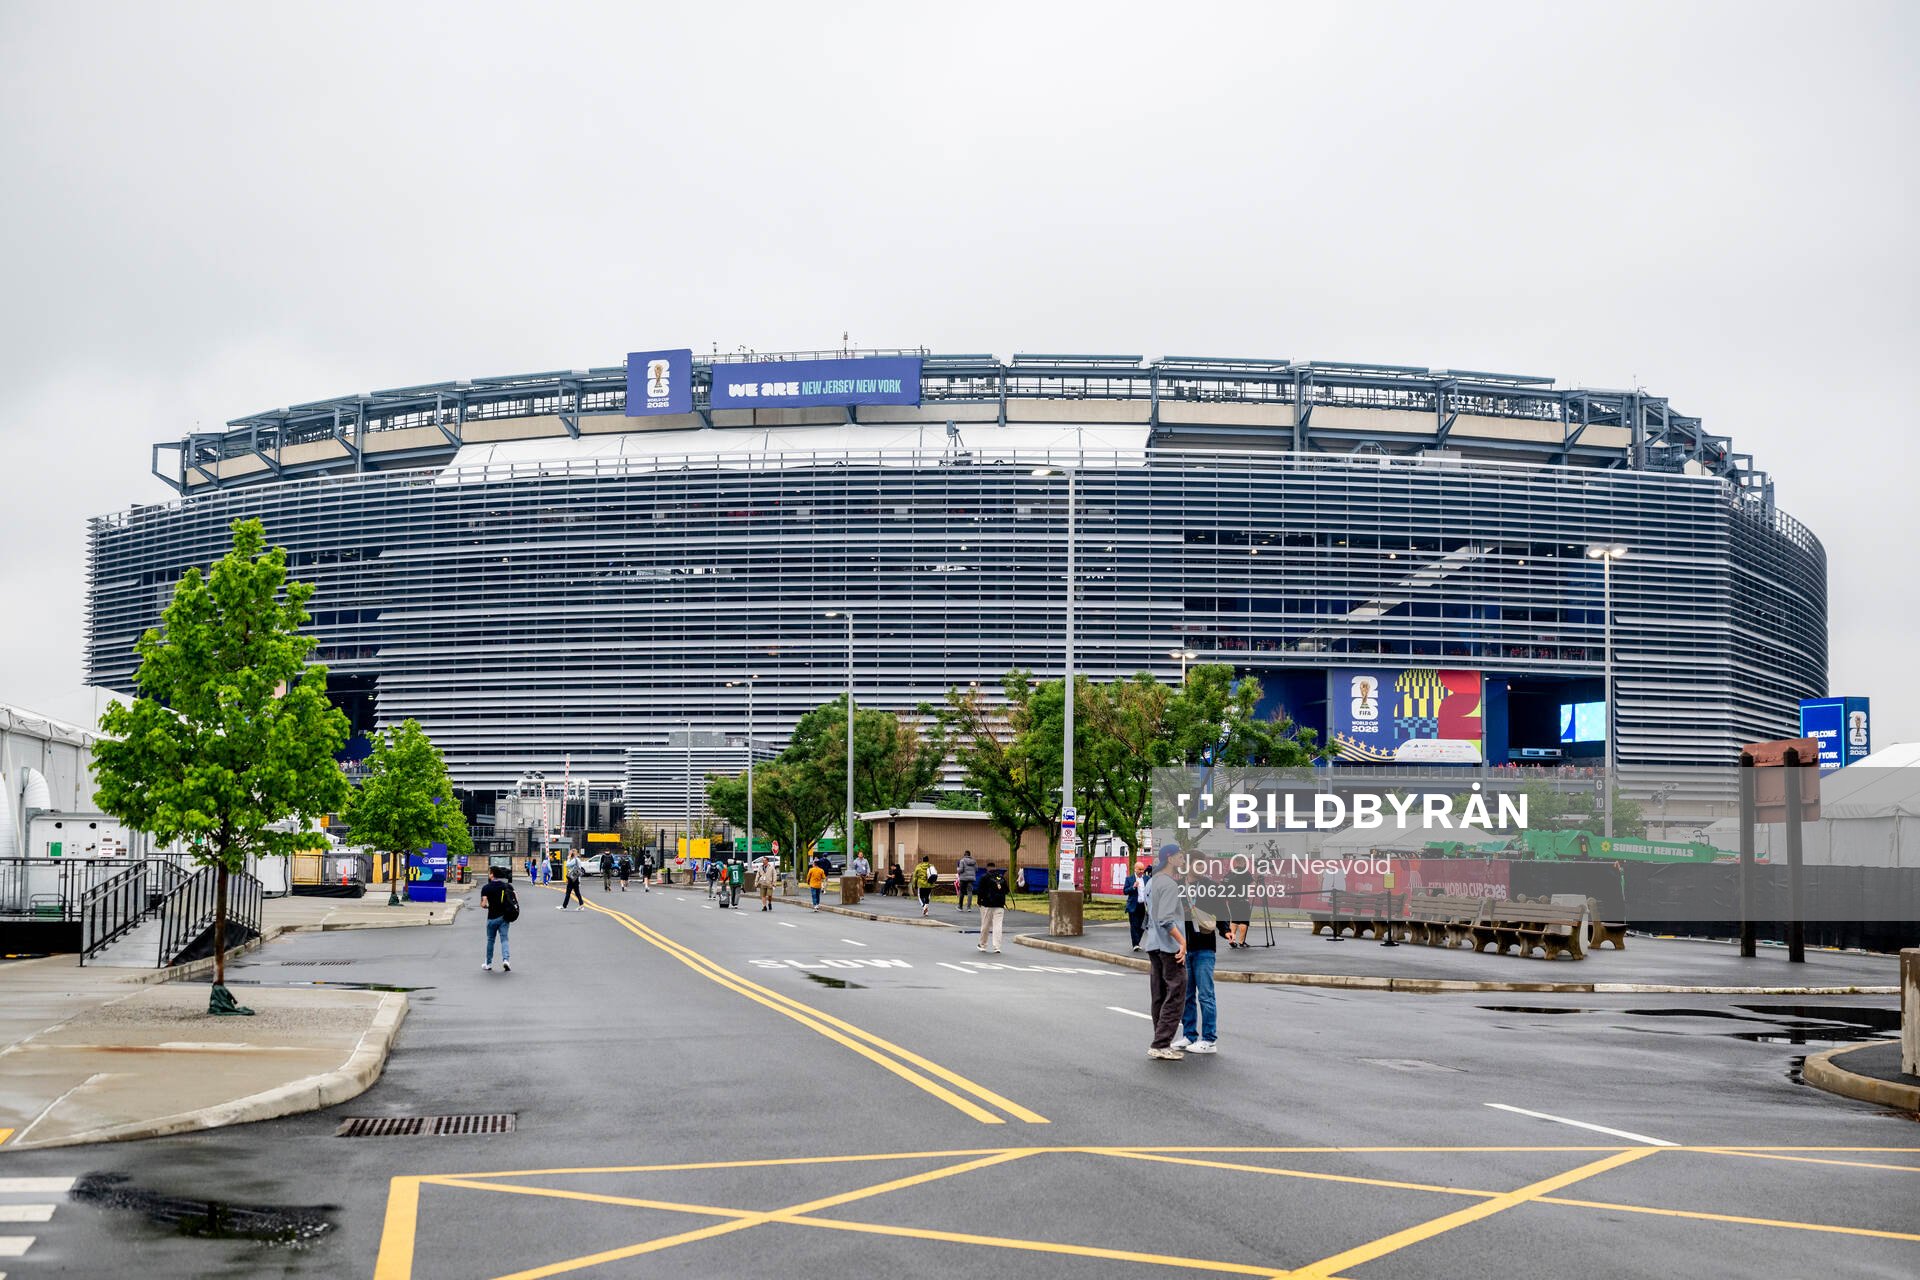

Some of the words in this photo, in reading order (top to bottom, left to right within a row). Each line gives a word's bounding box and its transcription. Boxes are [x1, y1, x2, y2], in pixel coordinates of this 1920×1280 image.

[802, 381, 822, 395] NEW
[823, 380, 854, 395] JERSEY
[856, 379, 877, 393] NEW
[878, 379, 902, 393] YORK
[646, 401, 669, 409] 2026
[1807, 730, 1837, 738] WELCOME
[1596, 780, 1603, 790] G
[1596, 797, 1604, 809] 10
[1613, 843, 1653, 854] SUNBELT
[1654, 846, 1693, 857] RENTALS
[1469, 883, 1484, 896] CUP
[748, 959, 913, 969] SLOW
